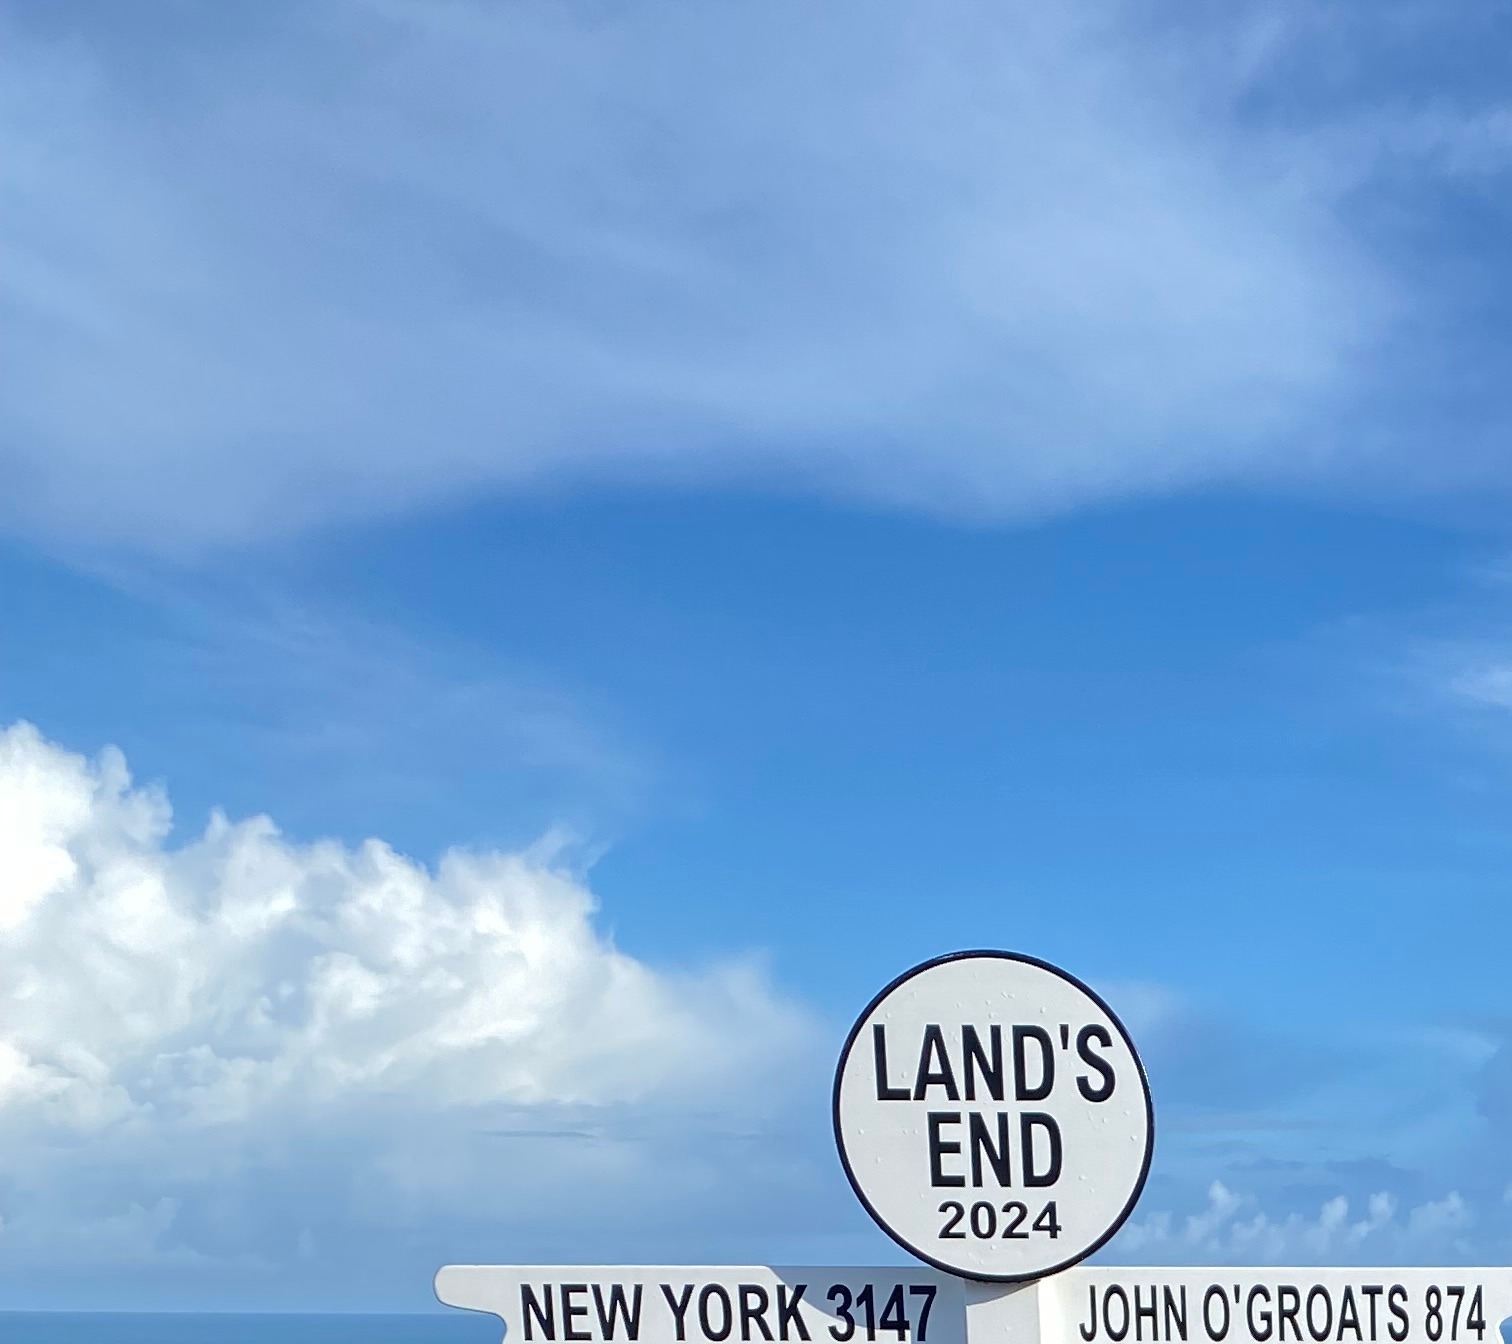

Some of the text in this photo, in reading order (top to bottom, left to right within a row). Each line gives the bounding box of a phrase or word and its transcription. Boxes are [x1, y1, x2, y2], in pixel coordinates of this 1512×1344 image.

[873, 1023, 1117, 1103] LAND'S
[927, 1111, 1064, 1189] END
[937, 1200, 1063, 1240] 2024
[520, 1283, 938, 1343] NEW YORK 3147
[1078, 1283, 1487, 1343] JOHN O'GROATS 874
